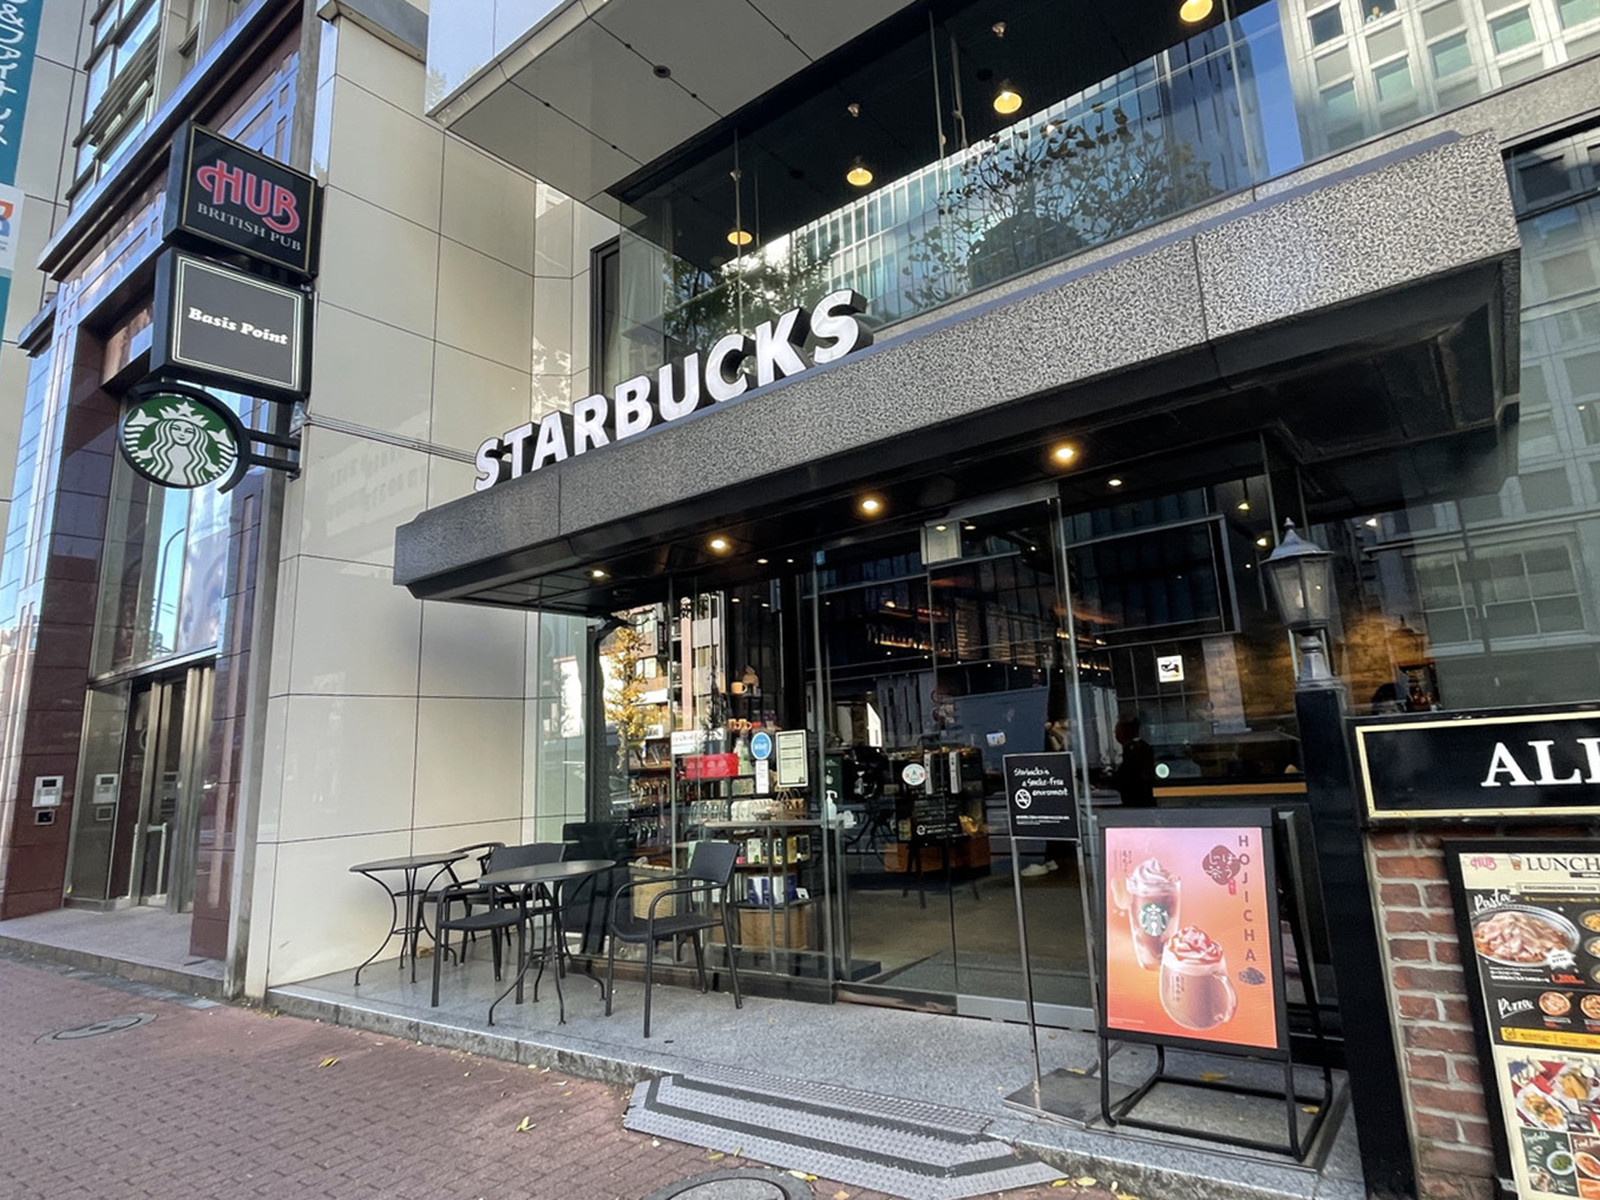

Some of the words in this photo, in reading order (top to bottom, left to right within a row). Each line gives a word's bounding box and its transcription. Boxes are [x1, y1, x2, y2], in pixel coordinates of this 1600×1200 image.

[196, 160, 300, 234] HUB
[198, 203, 265, 238] BRITISH
[270, 232, 302, 251] PUB
[188, 306, 237, 332] Basis
[240, 322, 289, 345] Point
[473, 288, 865, 493] STARBUCKS
[1525, 856, 1600, 871] LUNCH
[1238, 834, 1257, 962] HOJICHA
[1473, 888, 1514, 915] Pasta
[1498, 998, 1534, 1018] Pizza
